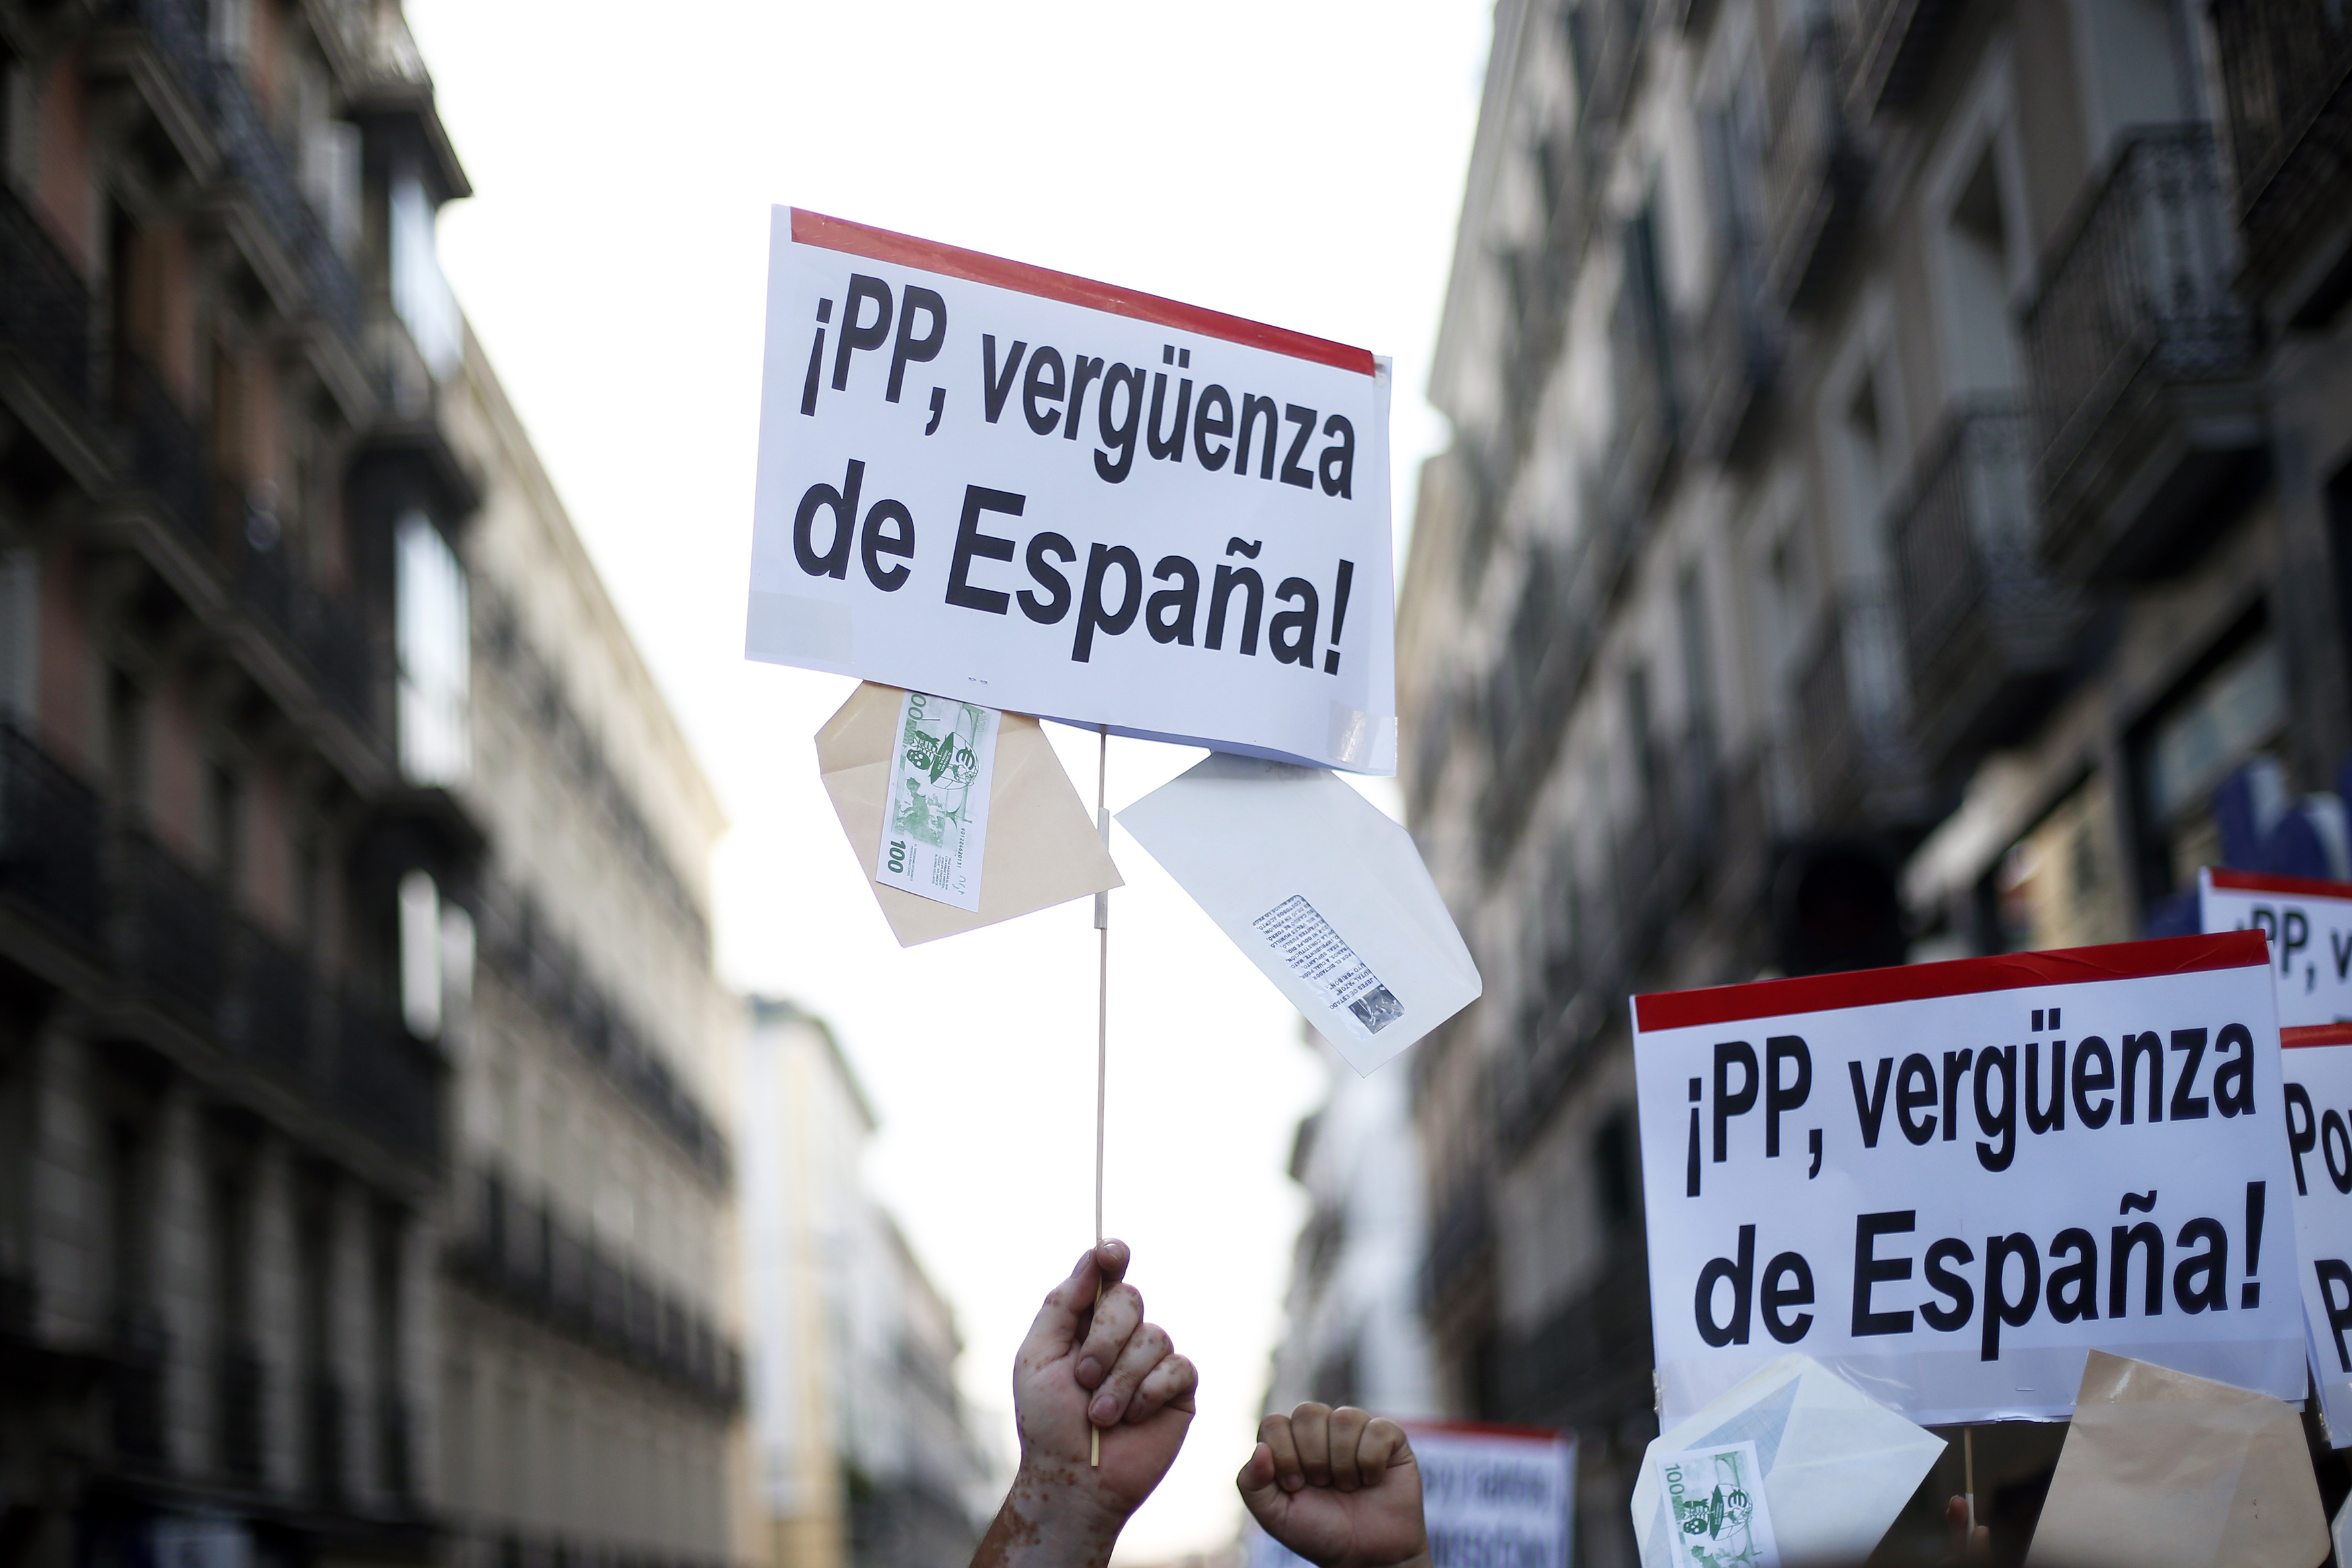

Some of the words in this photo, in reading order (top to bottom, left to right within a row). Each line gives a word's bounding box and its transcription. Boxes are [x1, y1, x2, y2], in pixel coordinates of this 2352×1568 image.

[801, 273, 947, 435] ¡PP,
[982, 333, 1355, 500] vergüenza
[794, 459, 915, 592] de
[944, 484, 1354, 676] España!
[888, 840, 905, 873] 100
[1296, 937, 1312, 948] GOLPE
[1341, 953, 1351, 961] POR
[1312, 963, 1335, 979] DICTADOR
[1313, 961, 1326, 970] CUAL
[1357, 977, 1373, 990] JEFES
[1687, 1036, 1822, 1196] ¡PP,
[1849, 1008, 2255, 1172] vergüenza
[1695, 1225, 1814, 1347] de
[1852, 1181, 2265, 1361] España!
[1665, 1464, 1684, 1495] 100
